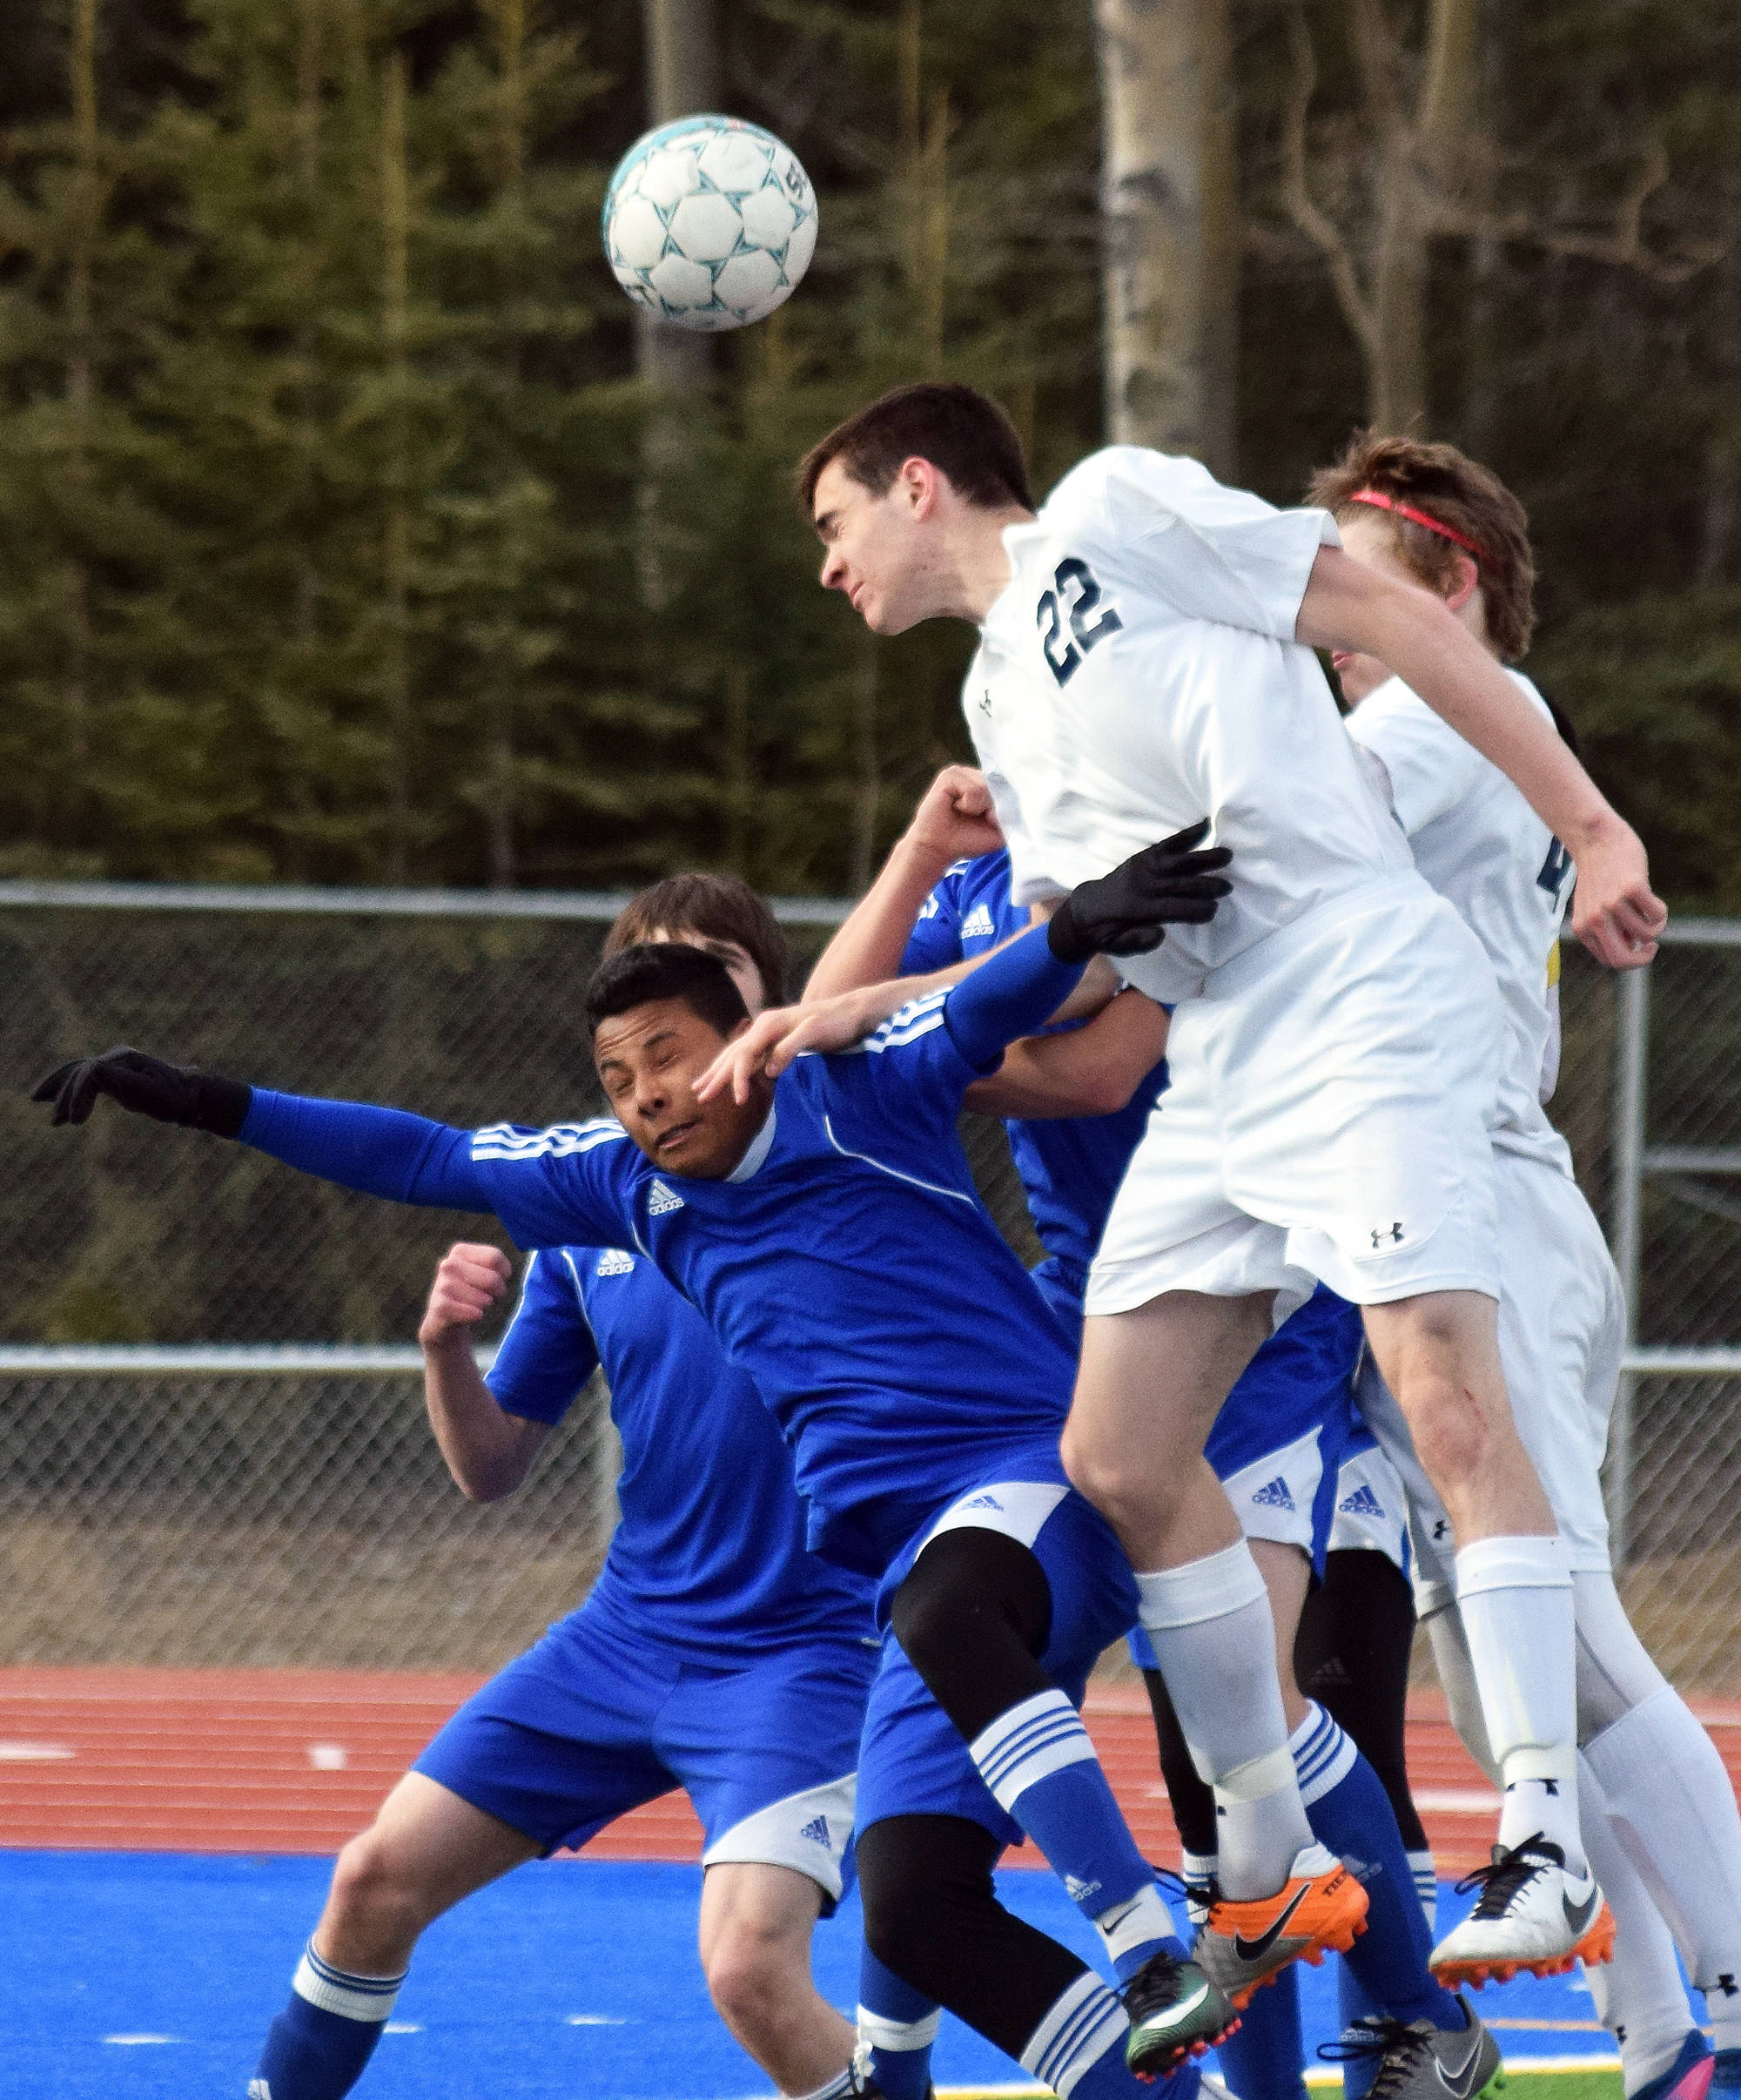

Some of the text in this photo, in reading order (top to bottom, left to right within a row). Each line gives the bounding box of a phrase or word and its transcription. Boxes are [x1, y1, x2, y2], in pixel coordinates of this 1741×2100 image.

[1036, 556, 1124, 690] 22
[649, 1197, 685, 1216] adidas
[597, 1261, 635, 1277] adidas
[1252, 1492, 1296, 1512] adidas
[1338, 1503, 1386, 1519] adidas
